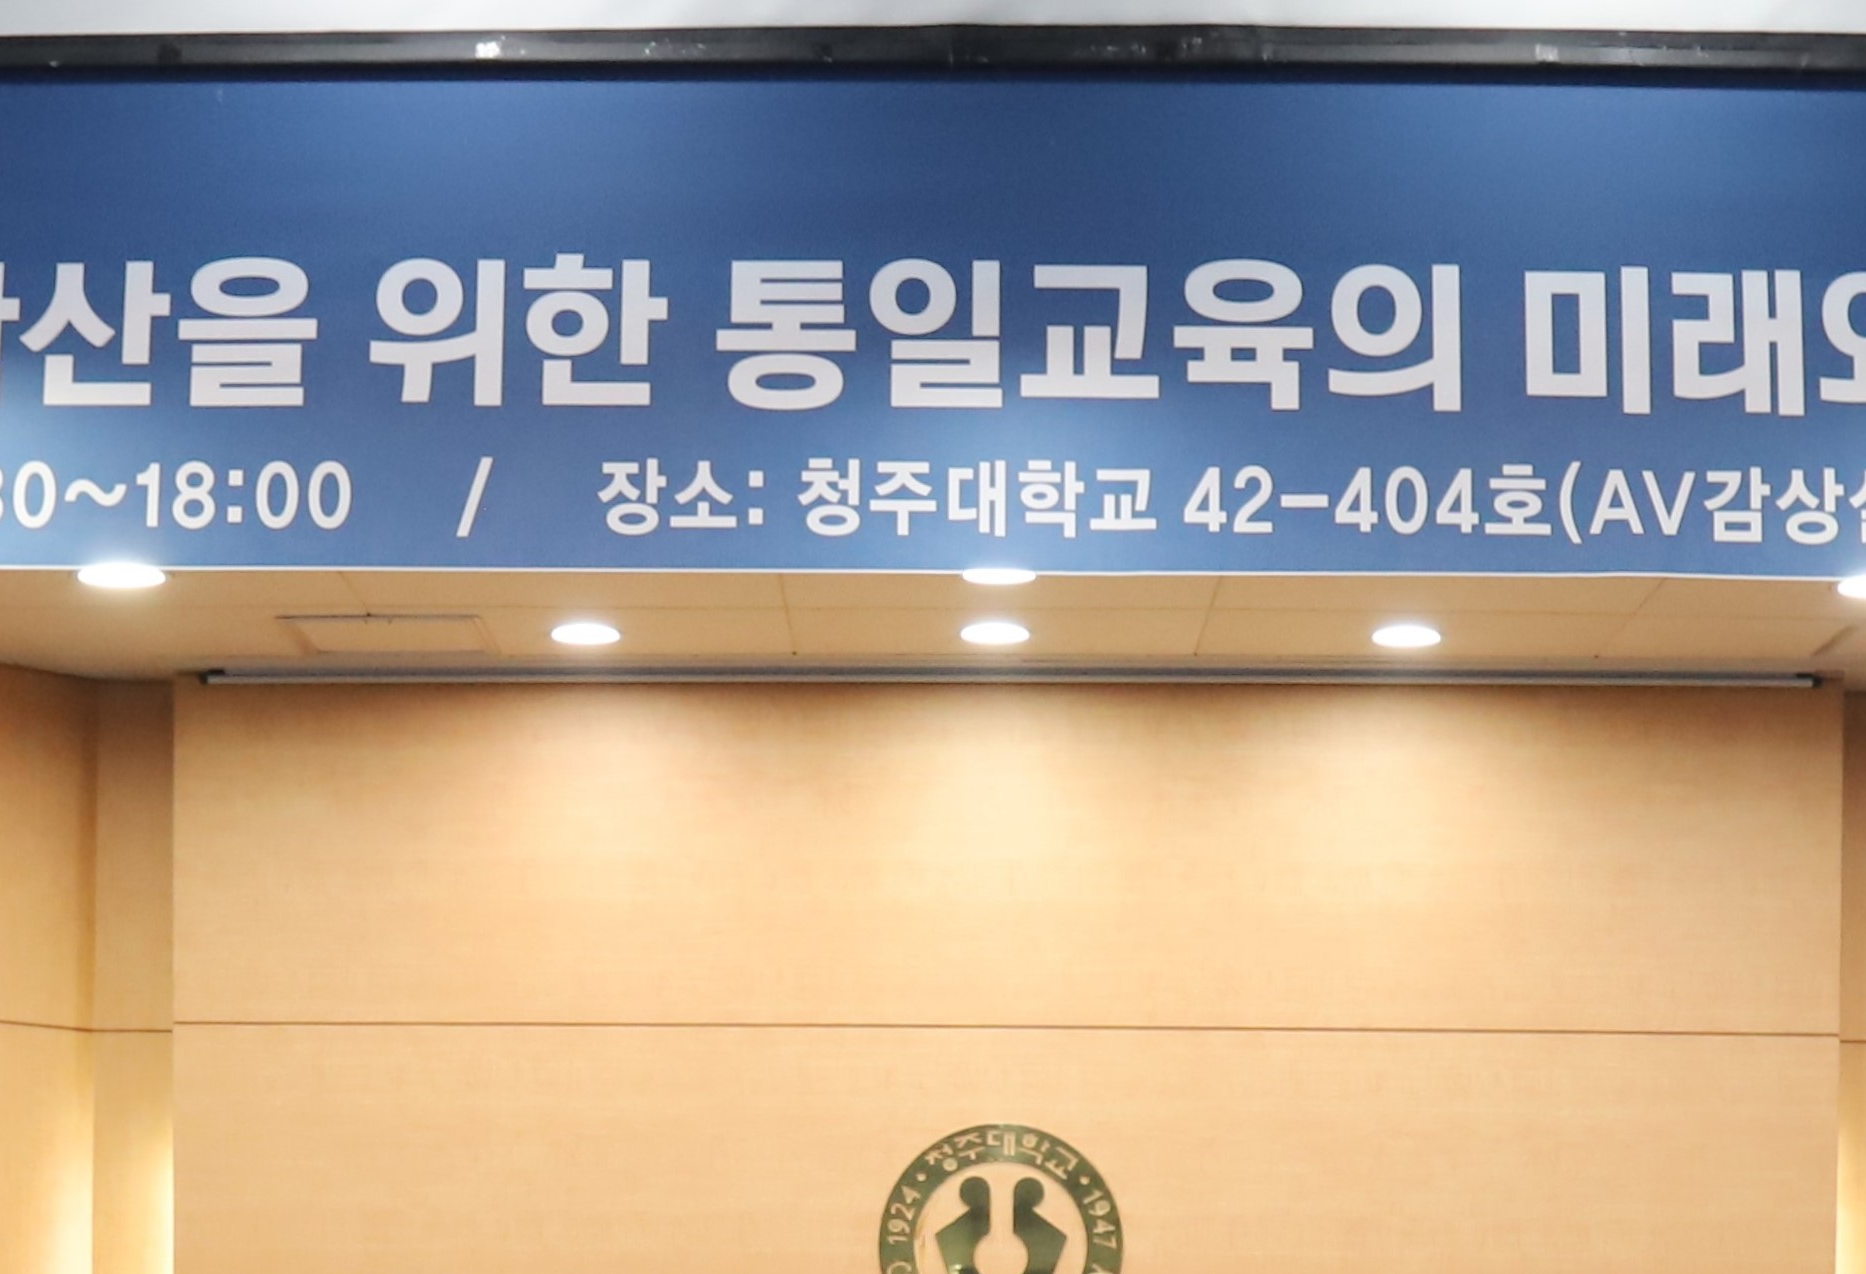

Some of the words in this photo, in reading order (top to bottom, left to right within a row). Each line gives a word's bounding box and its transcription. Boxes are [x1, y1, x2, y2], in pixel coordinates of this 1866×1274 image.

[369, 253, 669, 407] 위한
[715, 258, 1462, 412] 통일교육의
[597, 458, 764, 536] 장소:
[797, 458, 1157, 539] 청주대학교
[887, 1184, 922, 1245] 1924
[924, 1130, 1079, 1181] 청주대학교
[1082, 1189, 1118, 1250] 1947
